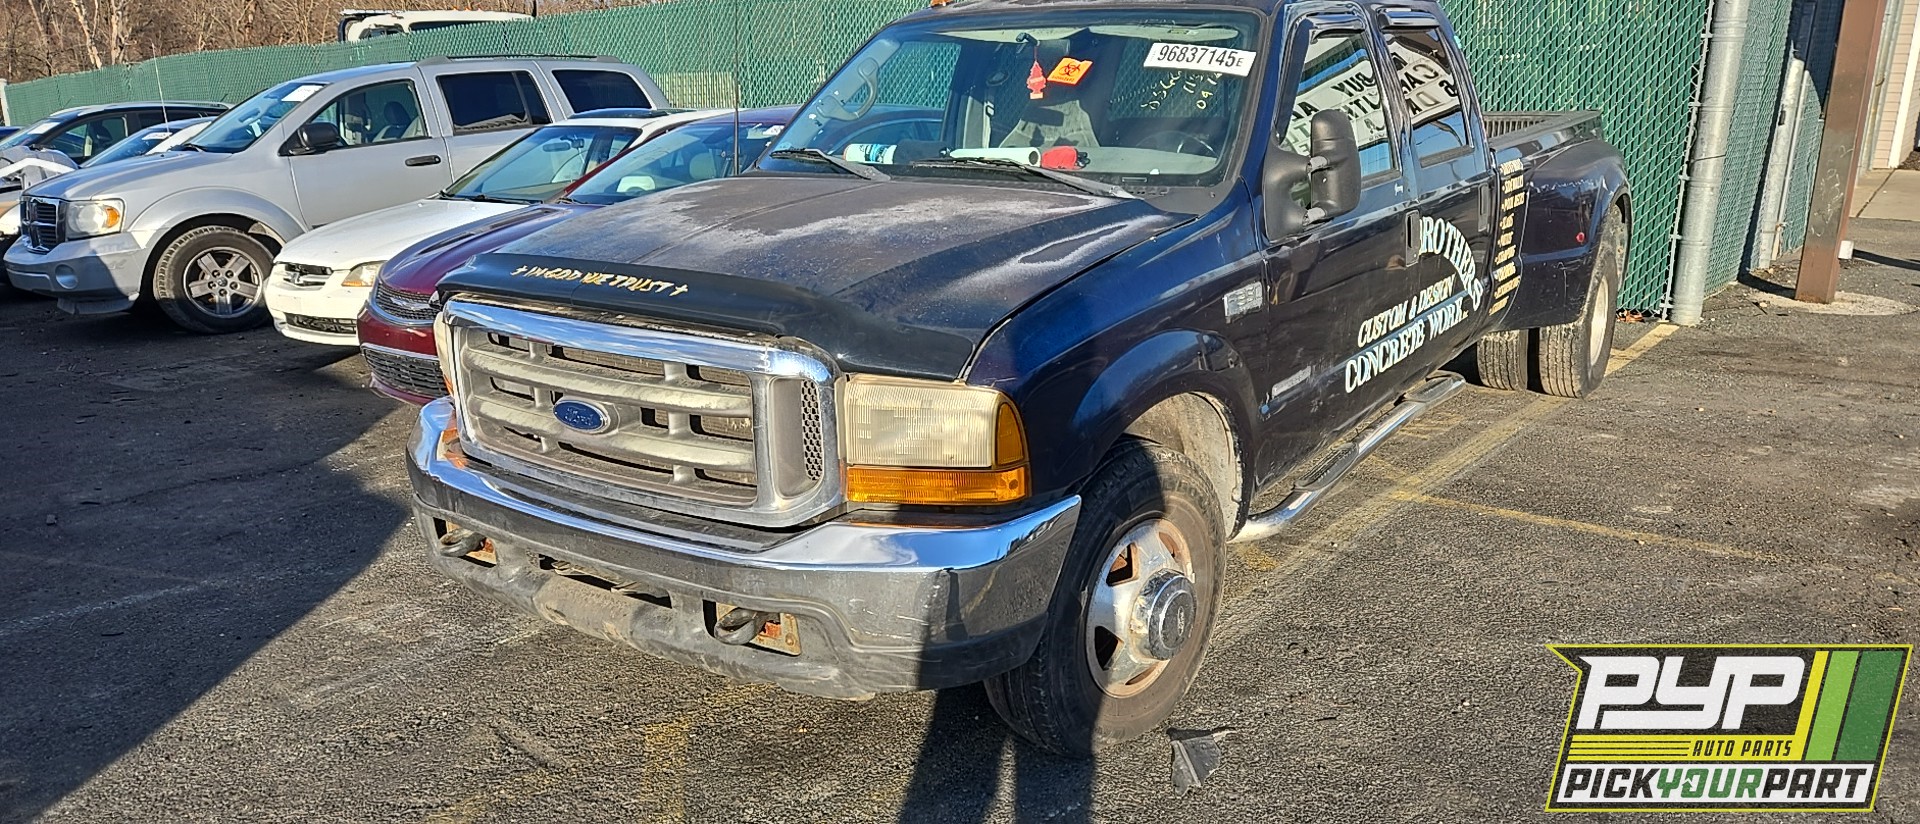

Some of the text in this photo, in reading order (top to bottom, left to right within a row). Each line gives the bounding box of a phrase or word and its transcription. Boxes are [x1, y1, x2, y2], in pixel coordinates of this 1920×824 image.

[523, 266, 675, 293] IN GOD WE TRUST
[1358, 300, 1408, 348] CUSTOM
[1416, 272, 1457, 314] DESIGN
[1345, 319, 1426, 393] CONCRETE
